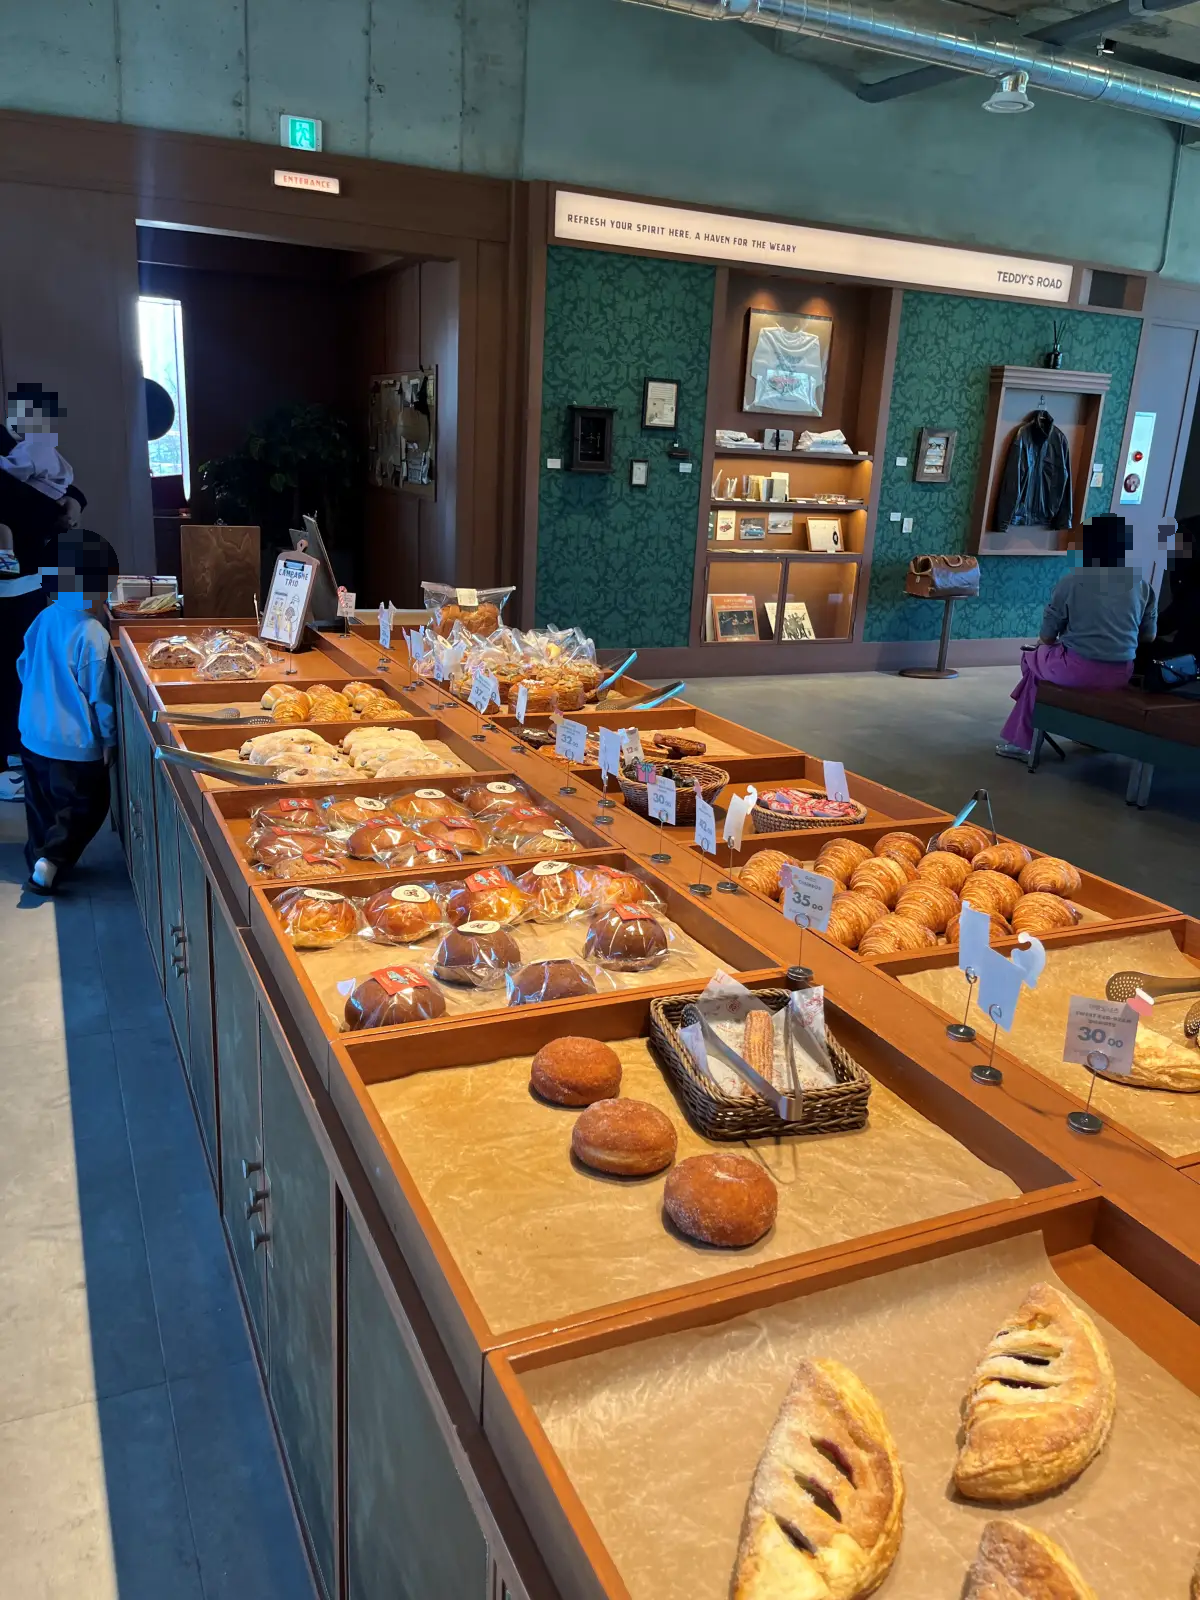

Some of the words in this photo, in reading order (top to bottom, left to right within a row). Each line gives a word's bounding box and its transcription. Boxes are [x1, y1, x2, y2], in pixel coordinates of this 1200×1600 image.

[567, 213, 606, 227] REFRESH
[610, 219, 632, 231] YOUR
[636, 223, 665, 236] SPIRIT
[695, 232, 701, 240] A
[704, 233, 730, 245] HAVEN
[733, 237, 748, 247] FOR
[751, 239, 766, 249] THE
[769, 242, 797, 254] WEARY
[997, 271, 1034, 286] TEDDY'S
[1036, 277, 1062, 289] ROAD
[278, 568, 309, 581] CAMPAGNE
[284, 578, 299, 588] TRIO
[561, 734, 573, 745] 32
[653, 792, 665, 805] 30
[792, 892, 810, 907] 35
[1077, 1026, 1106, 1044] 30
